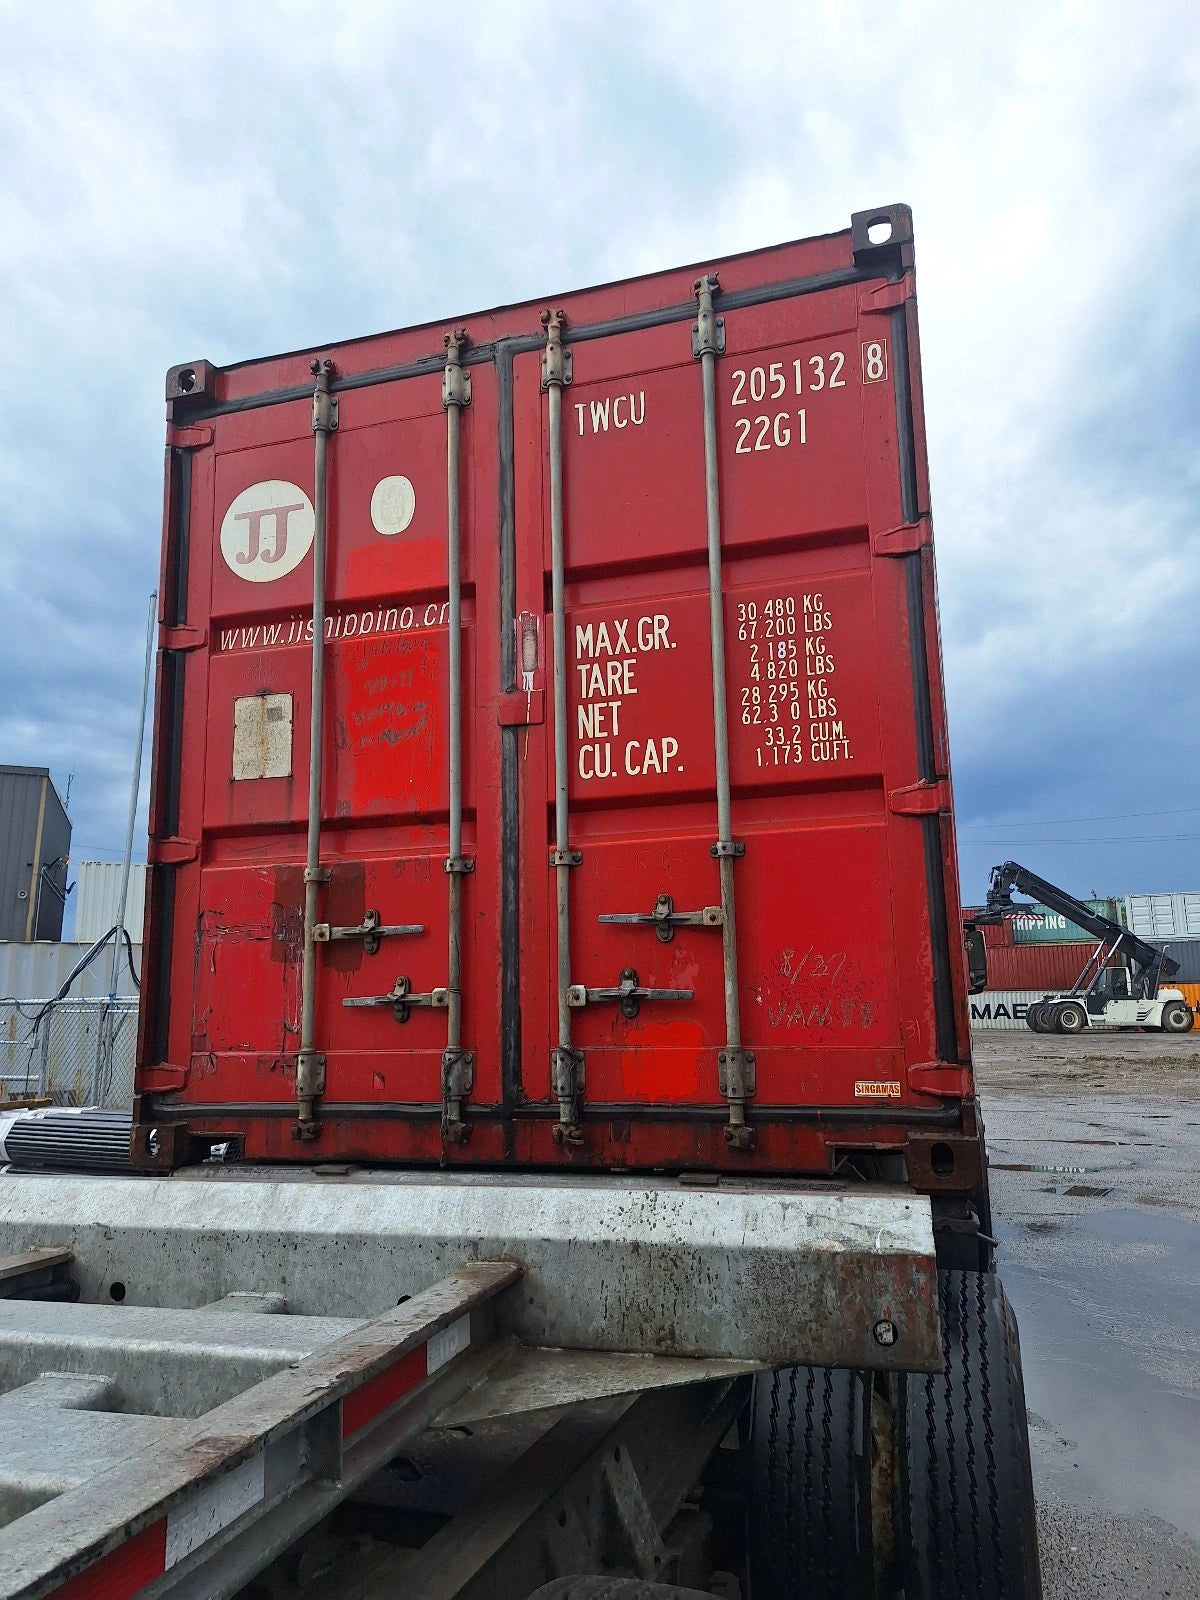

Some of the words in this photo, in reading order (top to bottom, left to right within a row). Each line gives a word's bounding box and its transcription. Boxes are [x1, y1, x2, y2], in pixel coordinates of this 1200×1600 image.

[732, 352, 845, 405] 205132
[866, 344, 884, 379] 8
[575, 391, 644, 435] TWCU
[735, 409, 805, 453] 22G1
[802, 593, 824, 613] KG
[803, 612, 833, 634] LBS
[576, 615, 676, 659] MAX.GR.
[805, 636, 827, 656] KG
[806, 655, 836, 677] LBS
[577, 658, 637, 698] TARE
[807, 679, 829, 699] KG
[578, 701, 621, 739] NET
[808, 699, 838, 720] LBS
[764, 725, 802, 746] 33.2
[810, 721, 847, 742] CU.M.
[579, 744, 617, 779] CU.
[625, 737, 683, 775] CAP.
[811, 740, 855, 762] CU.FT.
[854, 1083, 901, 1096] SINGAMAS
